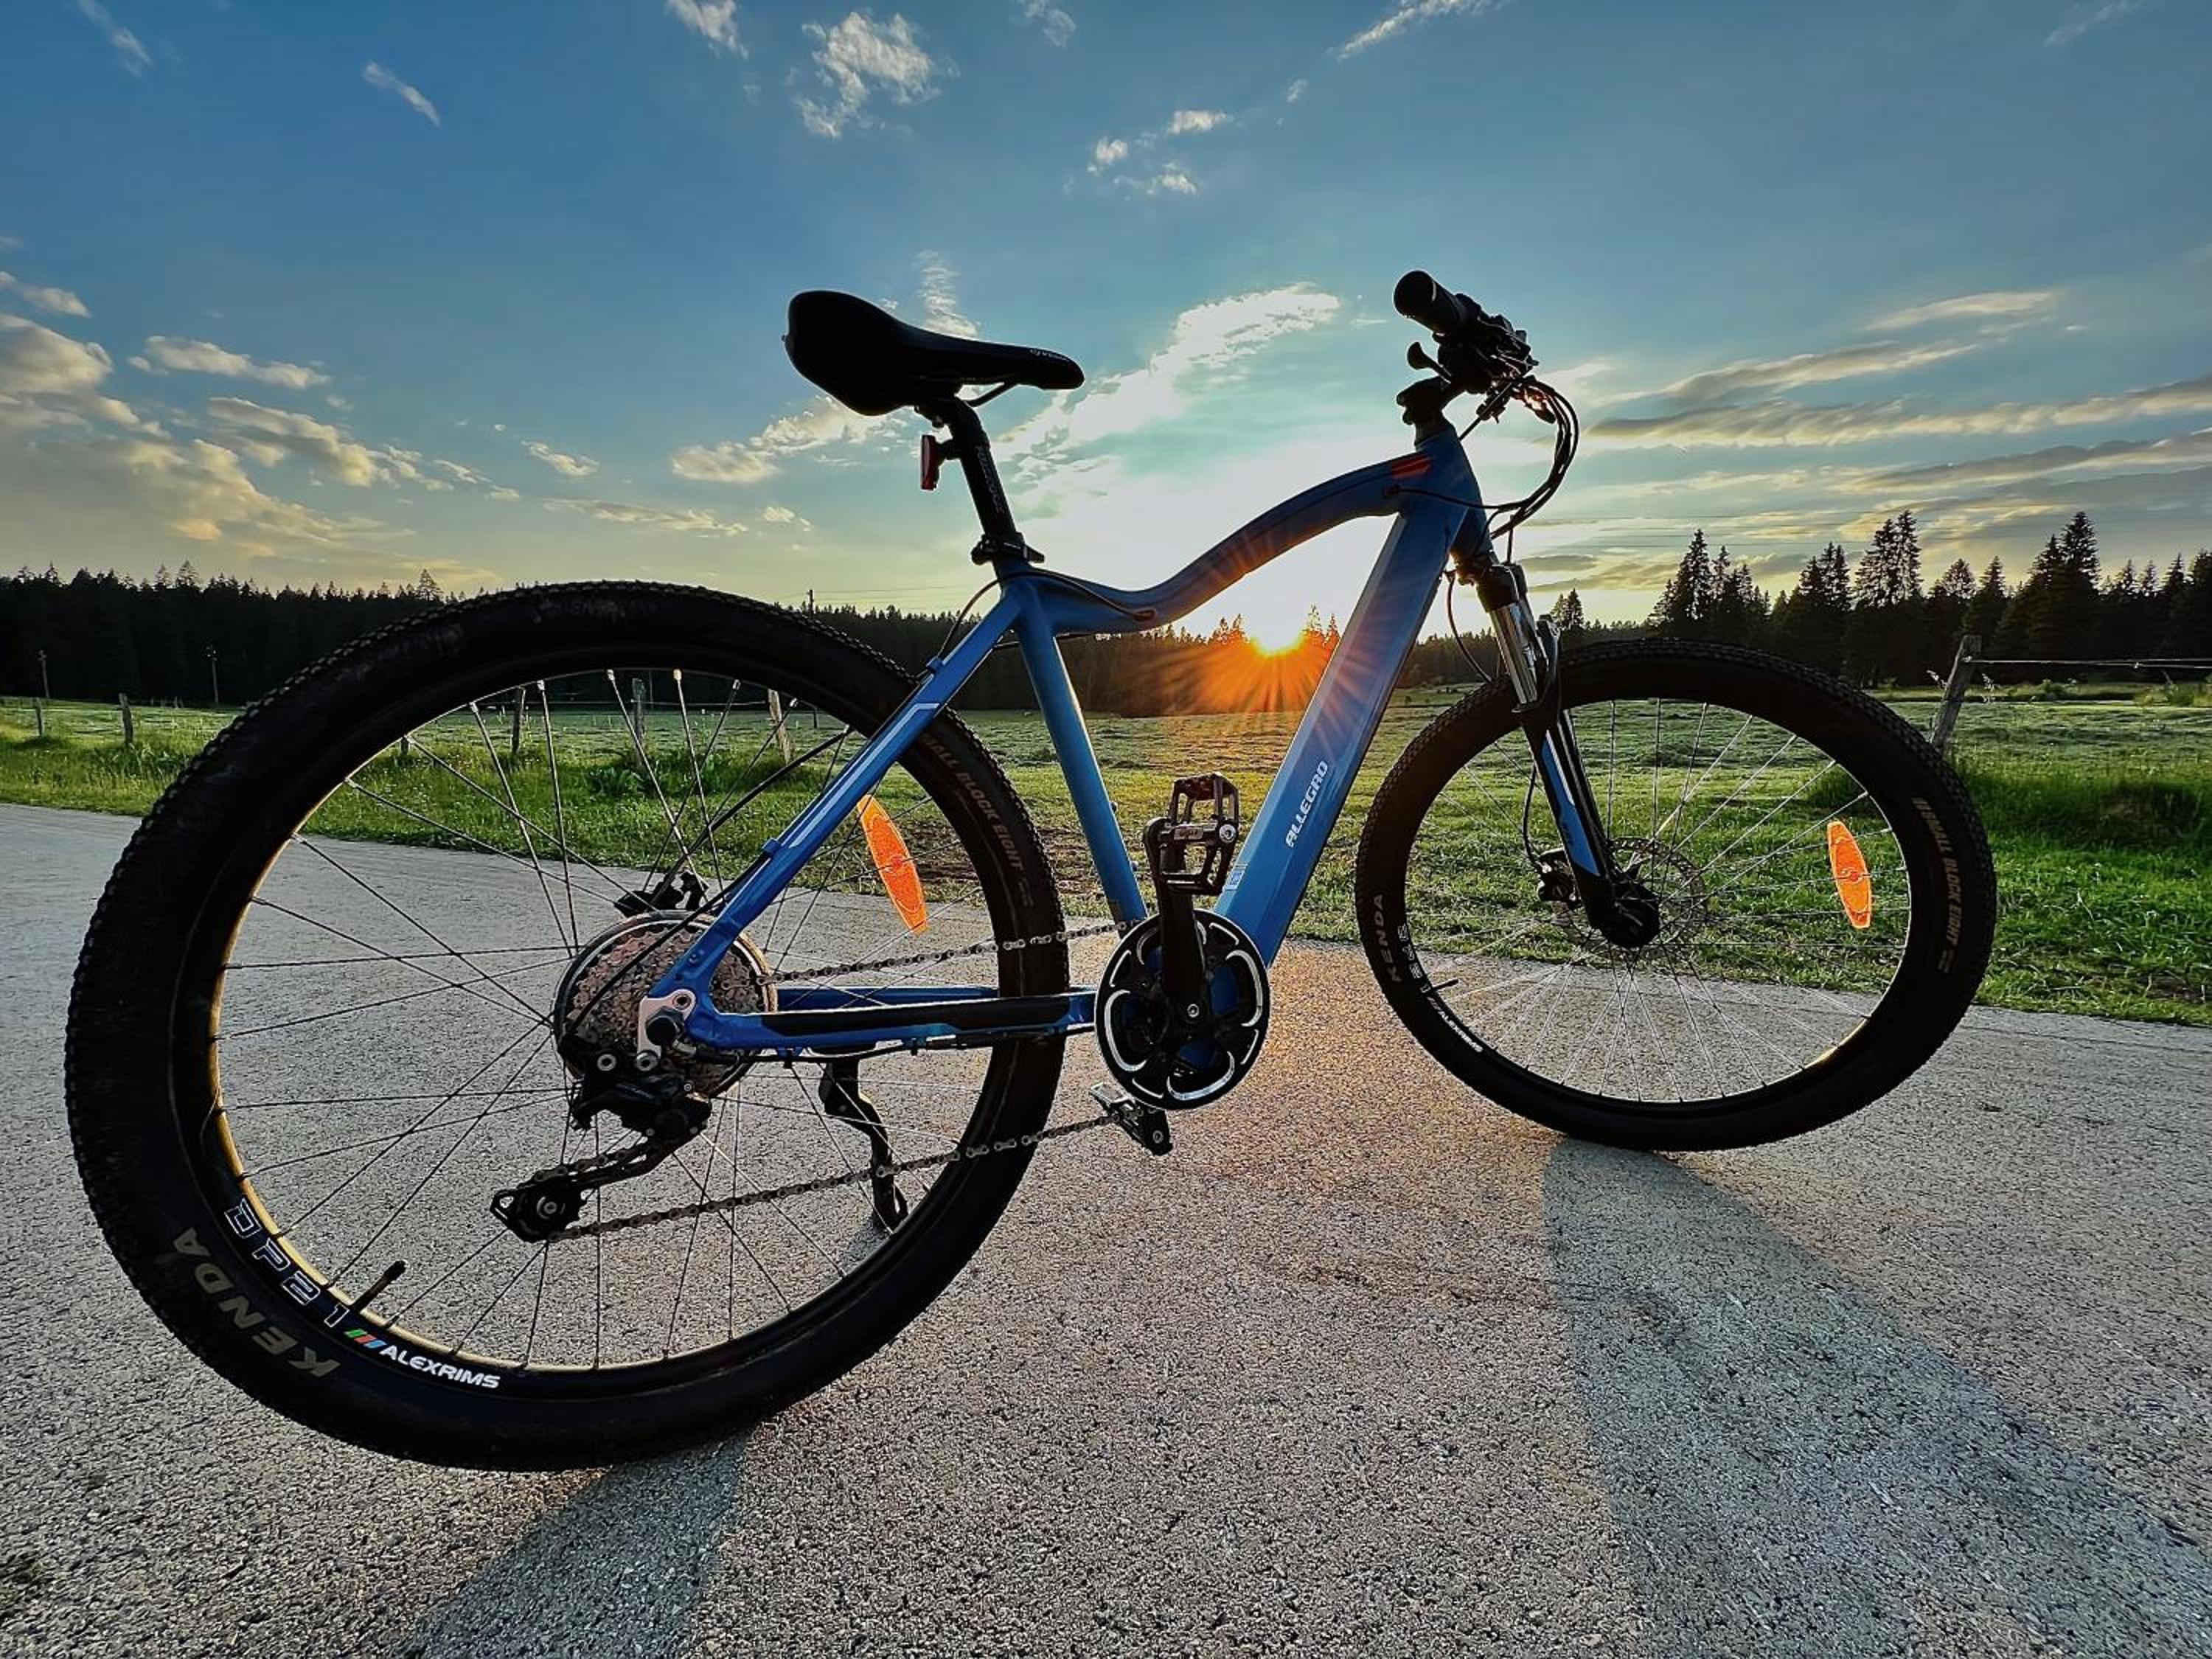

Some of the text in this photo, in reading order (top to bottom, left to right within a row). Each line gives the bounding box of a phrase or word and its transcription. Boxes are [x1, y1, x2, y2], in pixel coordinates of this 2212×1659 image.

[956, 772, 1000, 824] BLOCK
[995, 824, 1025, 871] EIGHT
[1285, 760, 1328, 848] ALLEGRO
[1943, 858, 1961, 903] BLOCK
[1947, 903, 1962, 945] EIGHT
[1373, 894, 1401, 982] KENDA
[173, 1227, 341, 1377] KENDA
[224, 1197, 349, 1327] DP21
[380, 1346, 500, 1389] ALEXRIMS
